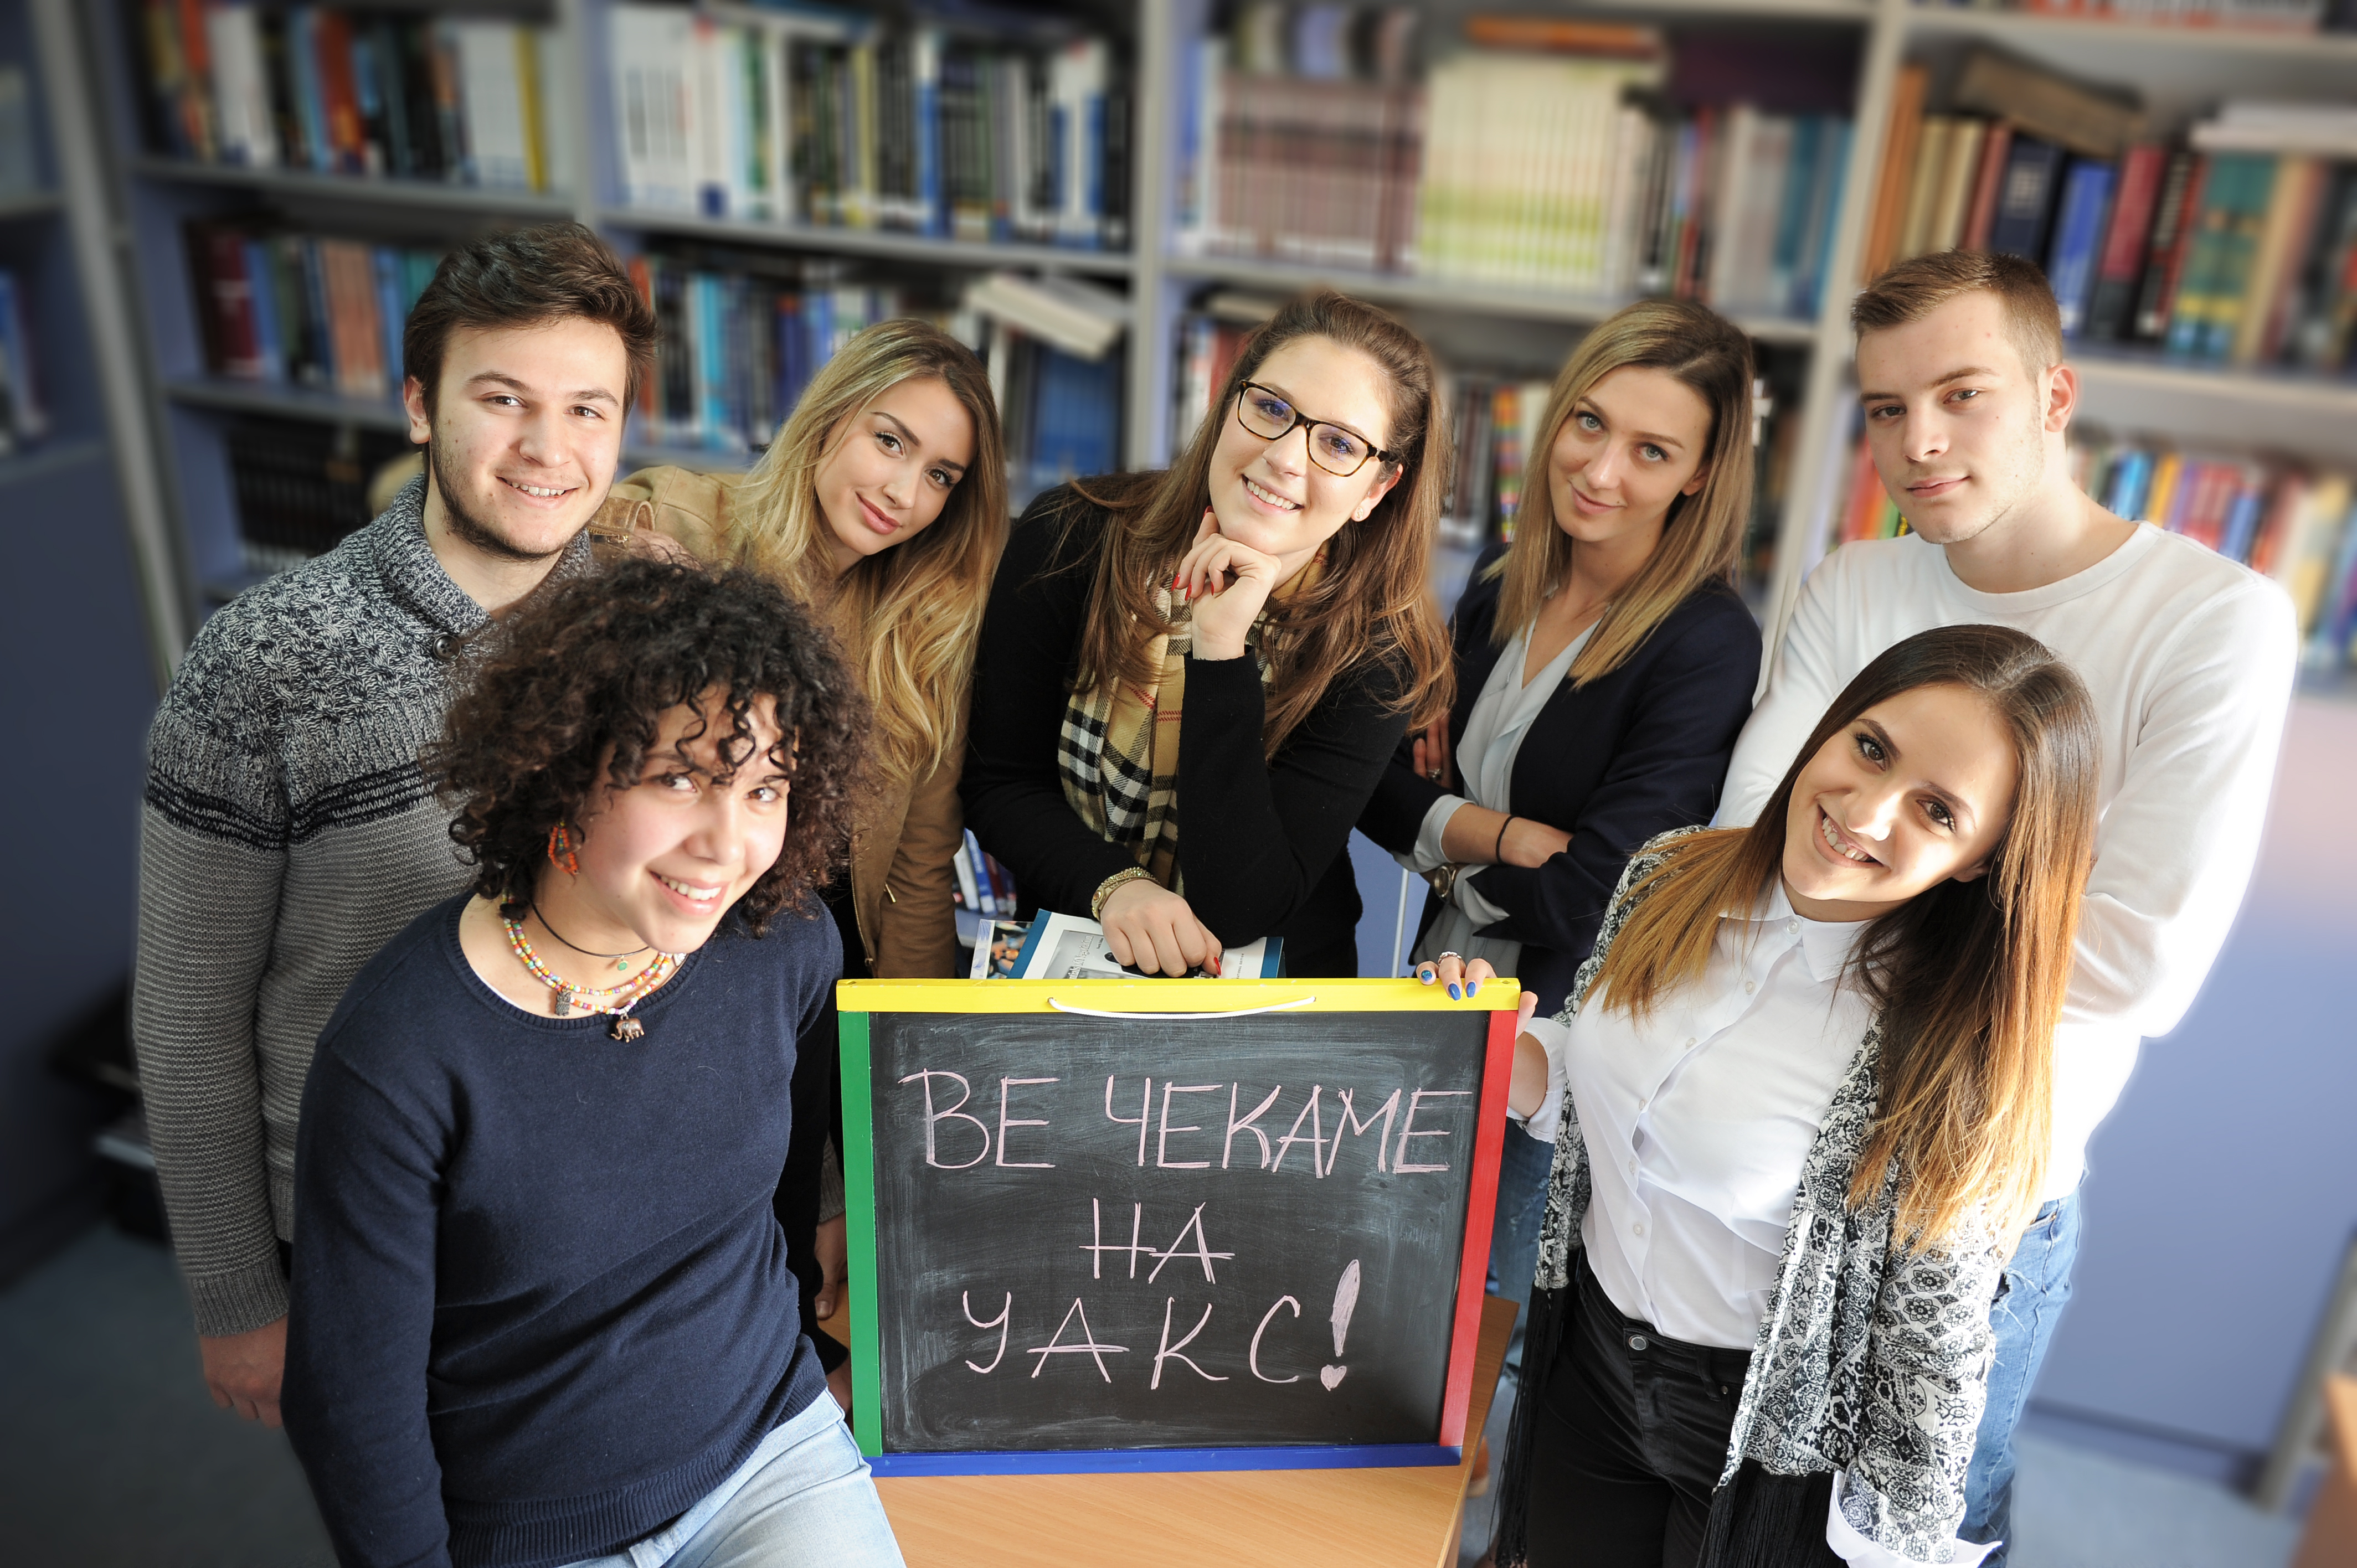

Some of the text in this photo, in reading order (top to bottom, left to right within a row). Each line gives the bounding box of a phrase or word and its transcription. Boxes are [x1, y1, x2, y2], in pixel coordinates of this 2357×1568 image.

[1074, 936, 1093, 962] Negotiation
[897, 1068, 1473, 1179] ВЕ ЧЕКАМЕ
[1078, 1197, 1235, 1285] НА
[962, 1258, 1361, 1391] УАКС!
